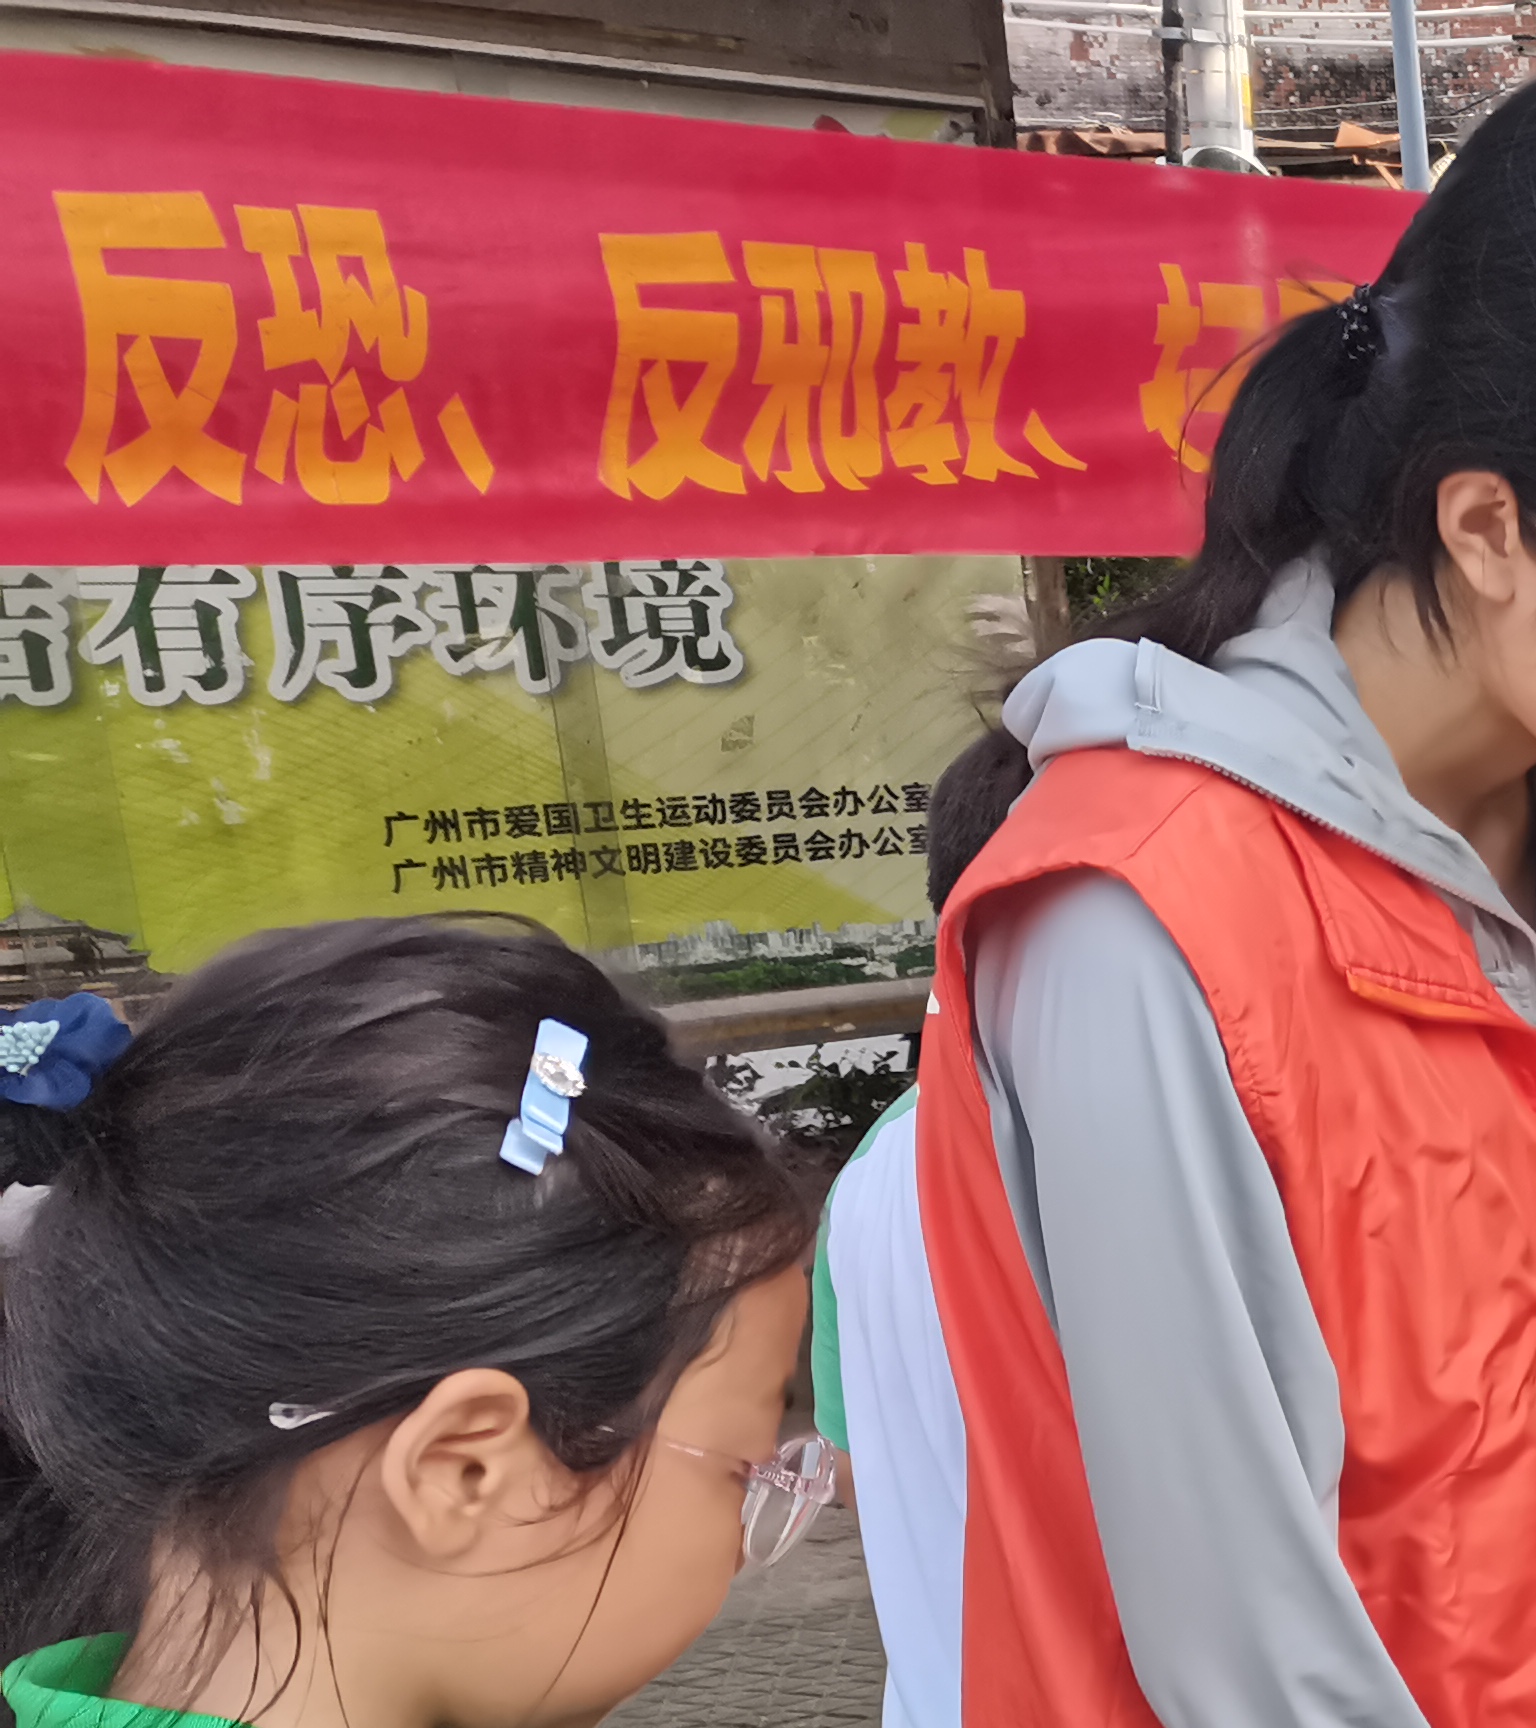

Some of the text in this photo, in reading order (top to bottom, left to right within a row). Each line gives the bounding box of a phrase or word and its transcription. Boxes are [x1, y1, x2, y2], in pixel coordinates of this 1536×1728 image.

[384, 782, 931, 847] 广州市爱国卫生运动委员会办公室
[392, 824, 928, 894] 广州市精神文明建设委员会办公室
